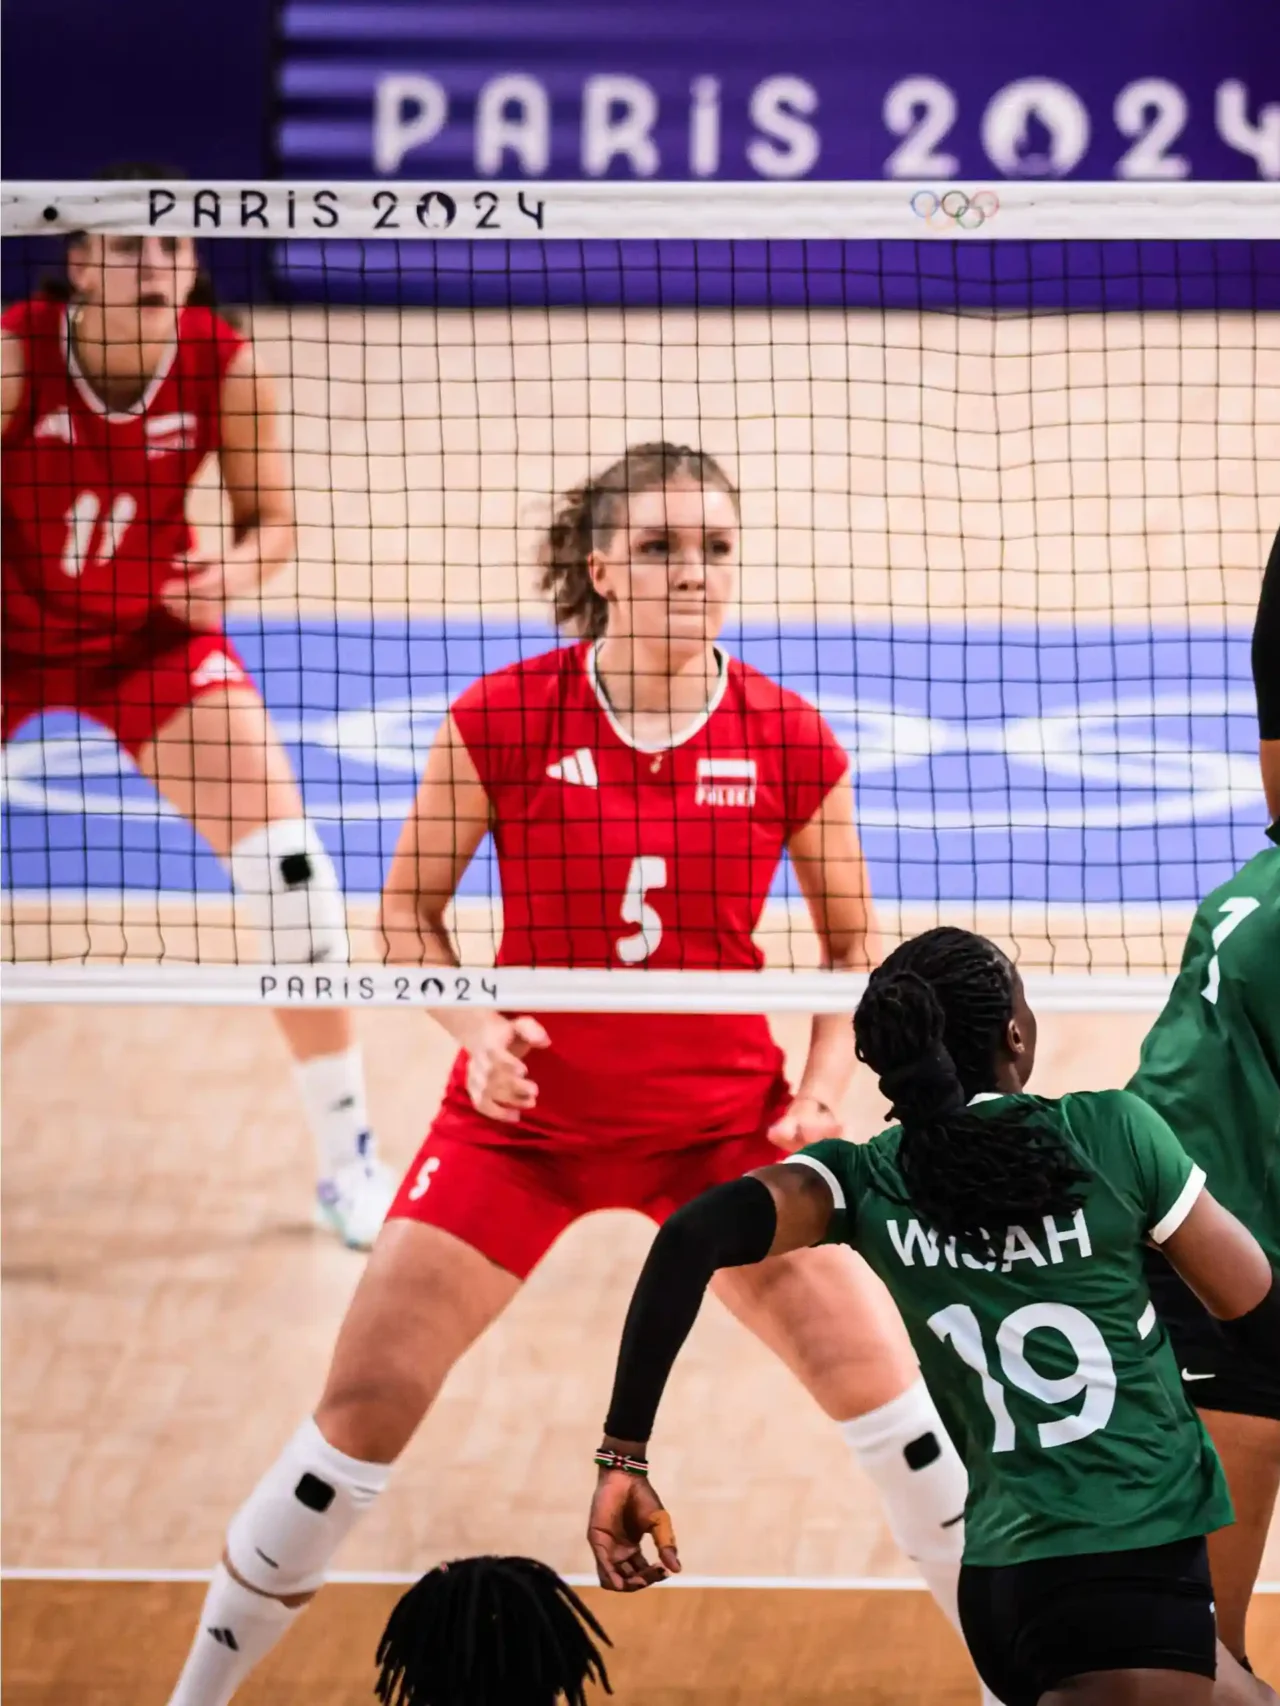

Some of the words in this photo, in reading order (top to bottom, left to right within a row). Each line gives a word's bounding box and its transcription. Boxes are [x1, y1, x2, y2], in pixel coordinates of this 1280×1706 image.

[373, 190, 544, 229] 2024
[60, 488, 138, 578] 11
[616, 855, 667, 966] 5
[394, 977, 497, 1001] 2024
[408, 1156, 441, 1201] 5
[926, 1302, 1117, 1453] 19
